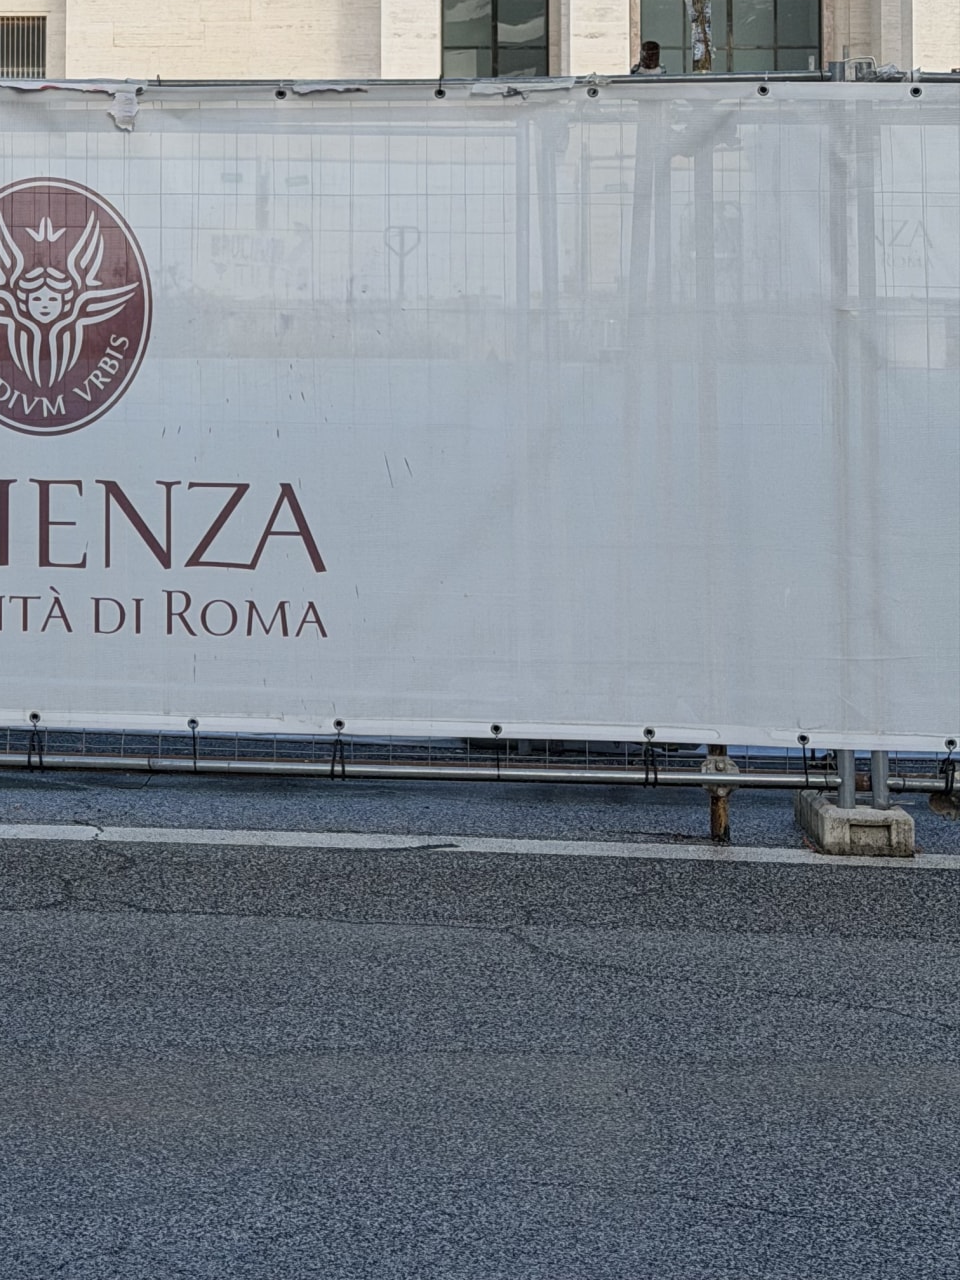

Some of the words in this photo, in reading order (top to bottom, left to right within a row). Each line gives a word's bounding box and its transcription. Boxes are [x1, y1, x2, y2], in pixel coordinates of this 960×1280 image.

[72, 333, 129, 402] VRBIS
[90, 596, 144, 635] DI
[161, 589, 328, 638] ROMA
